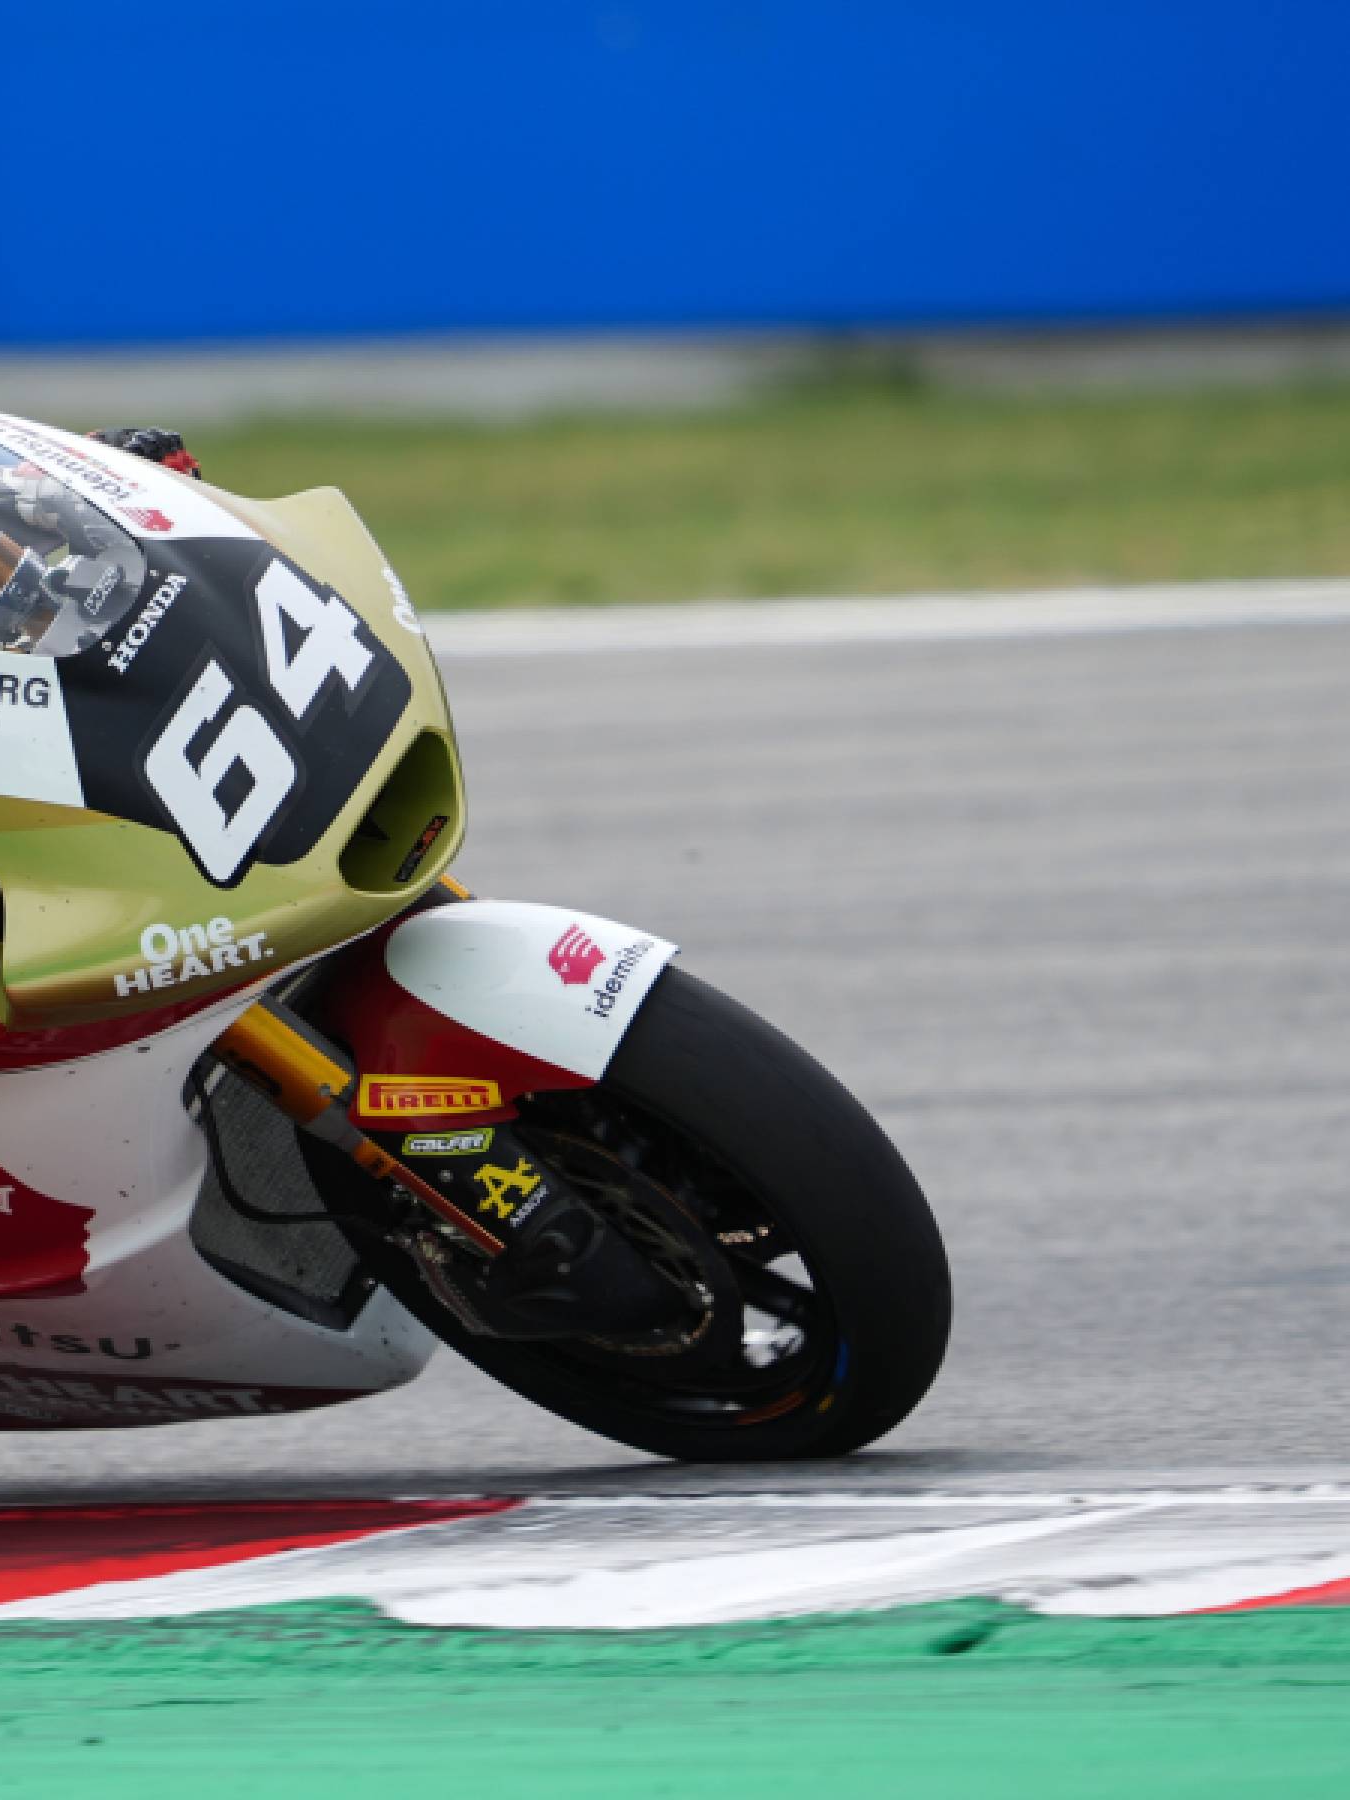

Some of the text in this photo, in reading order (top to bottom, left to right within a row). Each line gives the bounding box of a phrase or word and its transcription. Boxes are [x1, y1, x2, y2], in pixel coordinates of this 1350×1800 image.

[107, 573, 187, 674] HONDA
[144, 557, 375, 881] 64
[113, 931, 275, 997] HEART.
[140, 916, 234, 962] One
[367, 1081, 491, 1111] PIRELLI
